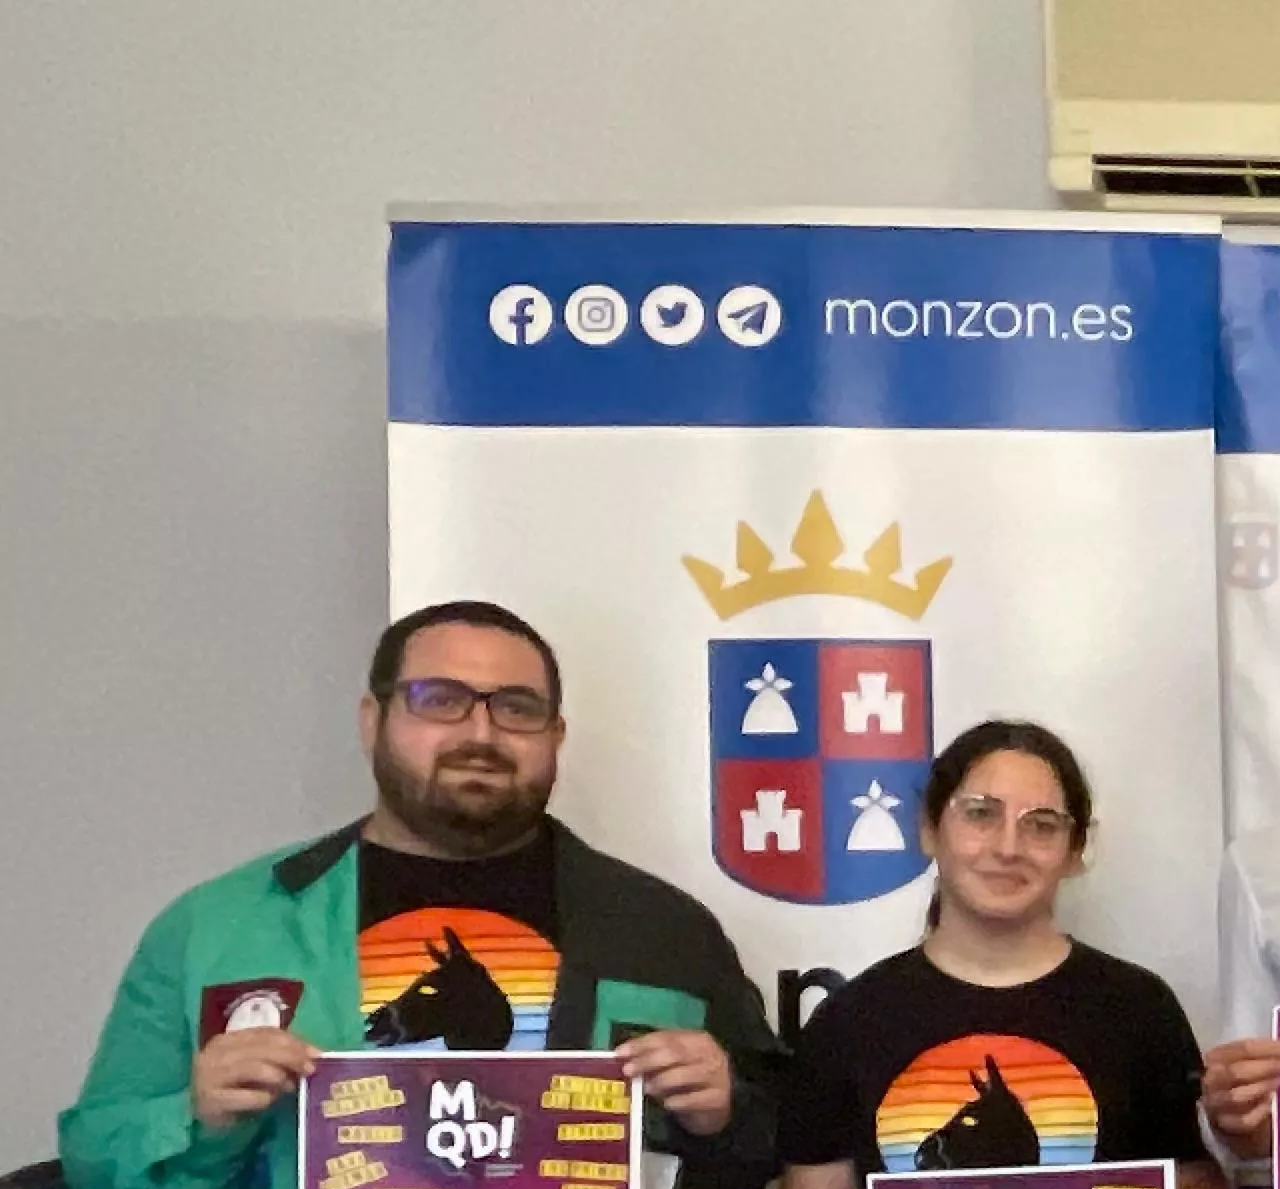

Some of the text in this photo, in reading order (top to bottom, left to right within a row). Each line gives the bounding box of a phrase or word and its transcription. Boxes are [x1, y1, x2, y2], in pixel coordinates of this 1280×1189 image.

[825, 293, 1133, 342] monzon.es
[430, 1080, 476, 1122] M
[426, 1116, 515, 1168] QD!
